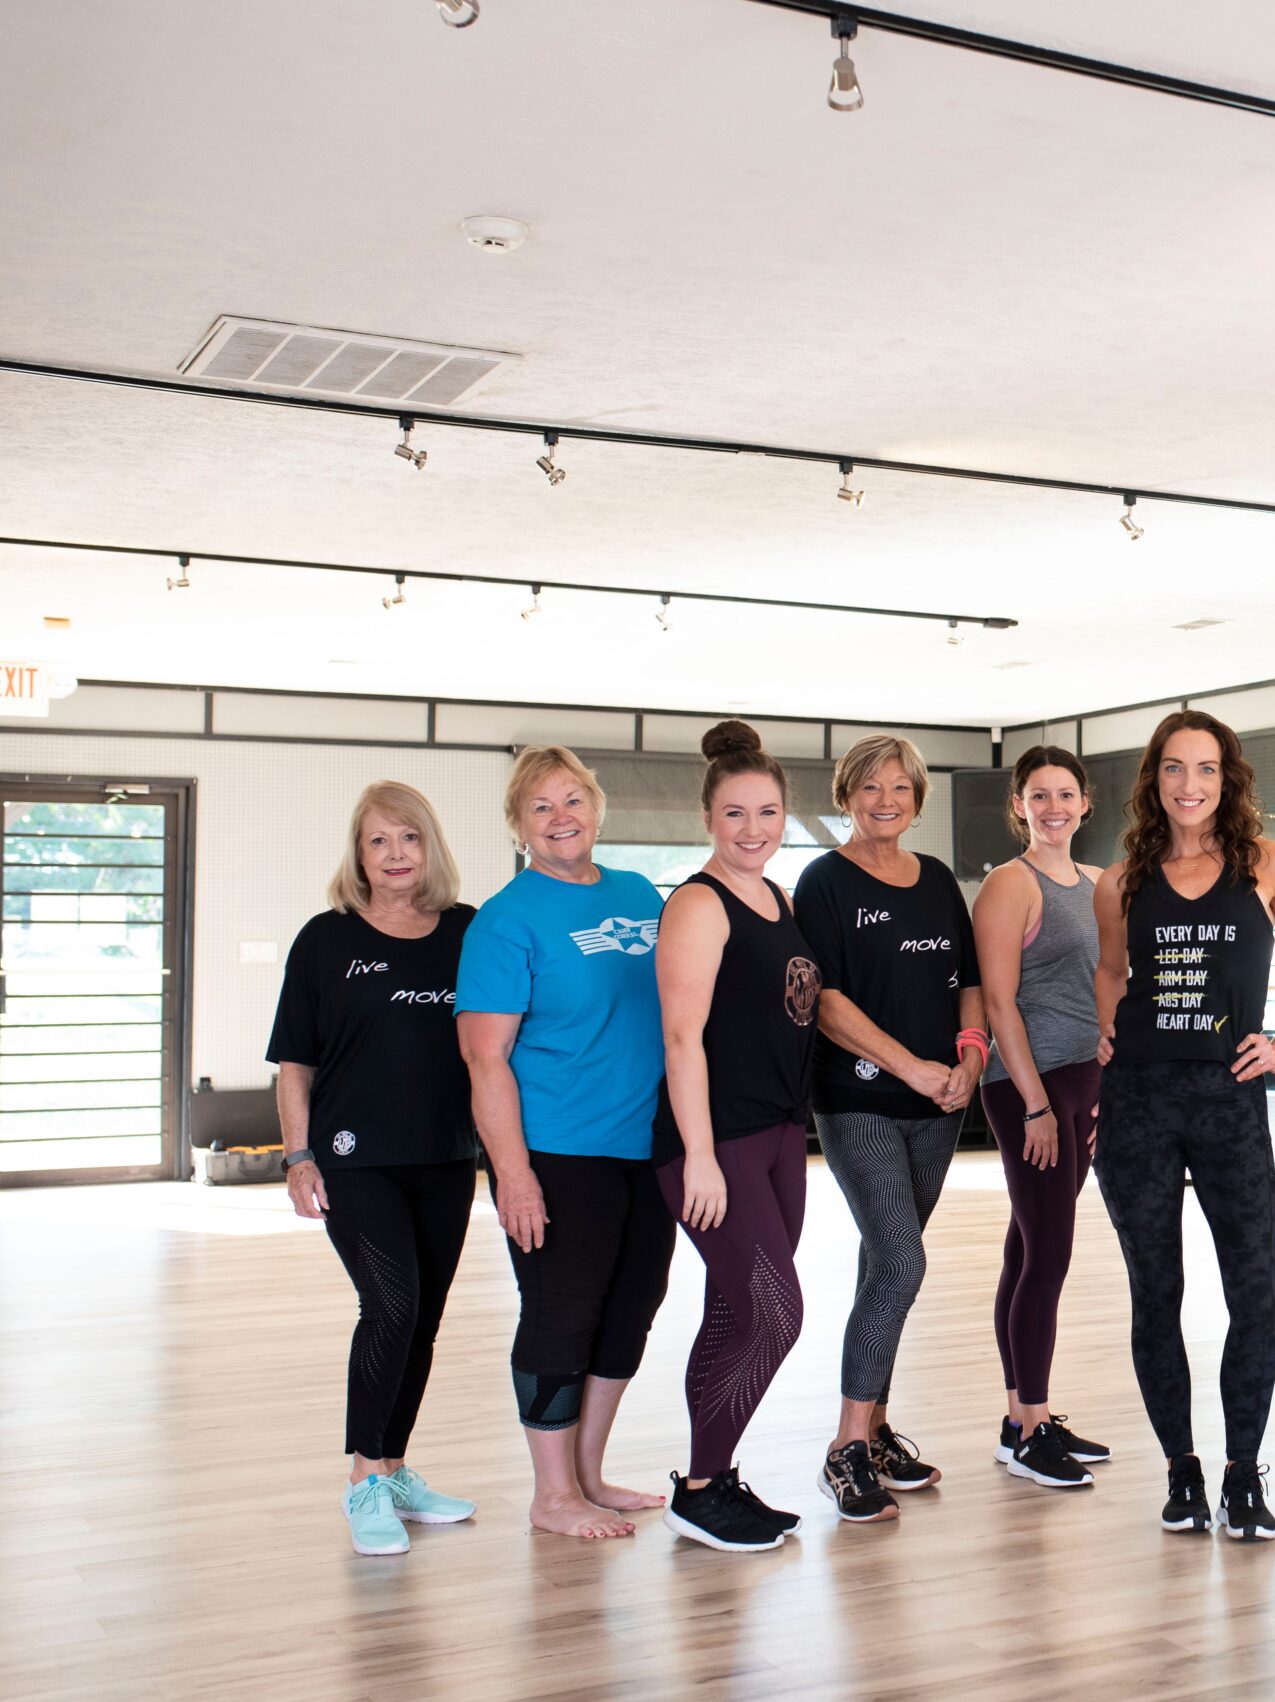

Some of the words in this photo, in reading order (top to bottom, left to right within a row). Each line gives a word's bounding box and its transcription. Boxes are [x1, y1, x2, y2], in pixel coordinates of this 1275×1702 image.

[0, 667, 38, 698] XIT
[857, 908, 891, 928] live
[1155, 925, 1193, 944] EVERY
[1198, 924, 1221, 941] DAY
[1224, 925, 1237, 942] IS
[900, 936, 952, 953] move
[1159, 948, 1179, 965] LEG
[1183, 947, 1205, 964] DAY
[345, 959, 390, 979] live
[1158, 970, 1182, 987] ARM
[1186, 970, 1208, 987] DAY
[390, 988, 457, 1004] move
[1158, 992, 1178, 1008] ABS
[1182, 992, 1202, 1008] DAY
[1156, 1013, 1191, 1030] HEART
[1193, 1014, 1214, 1031] DAY
